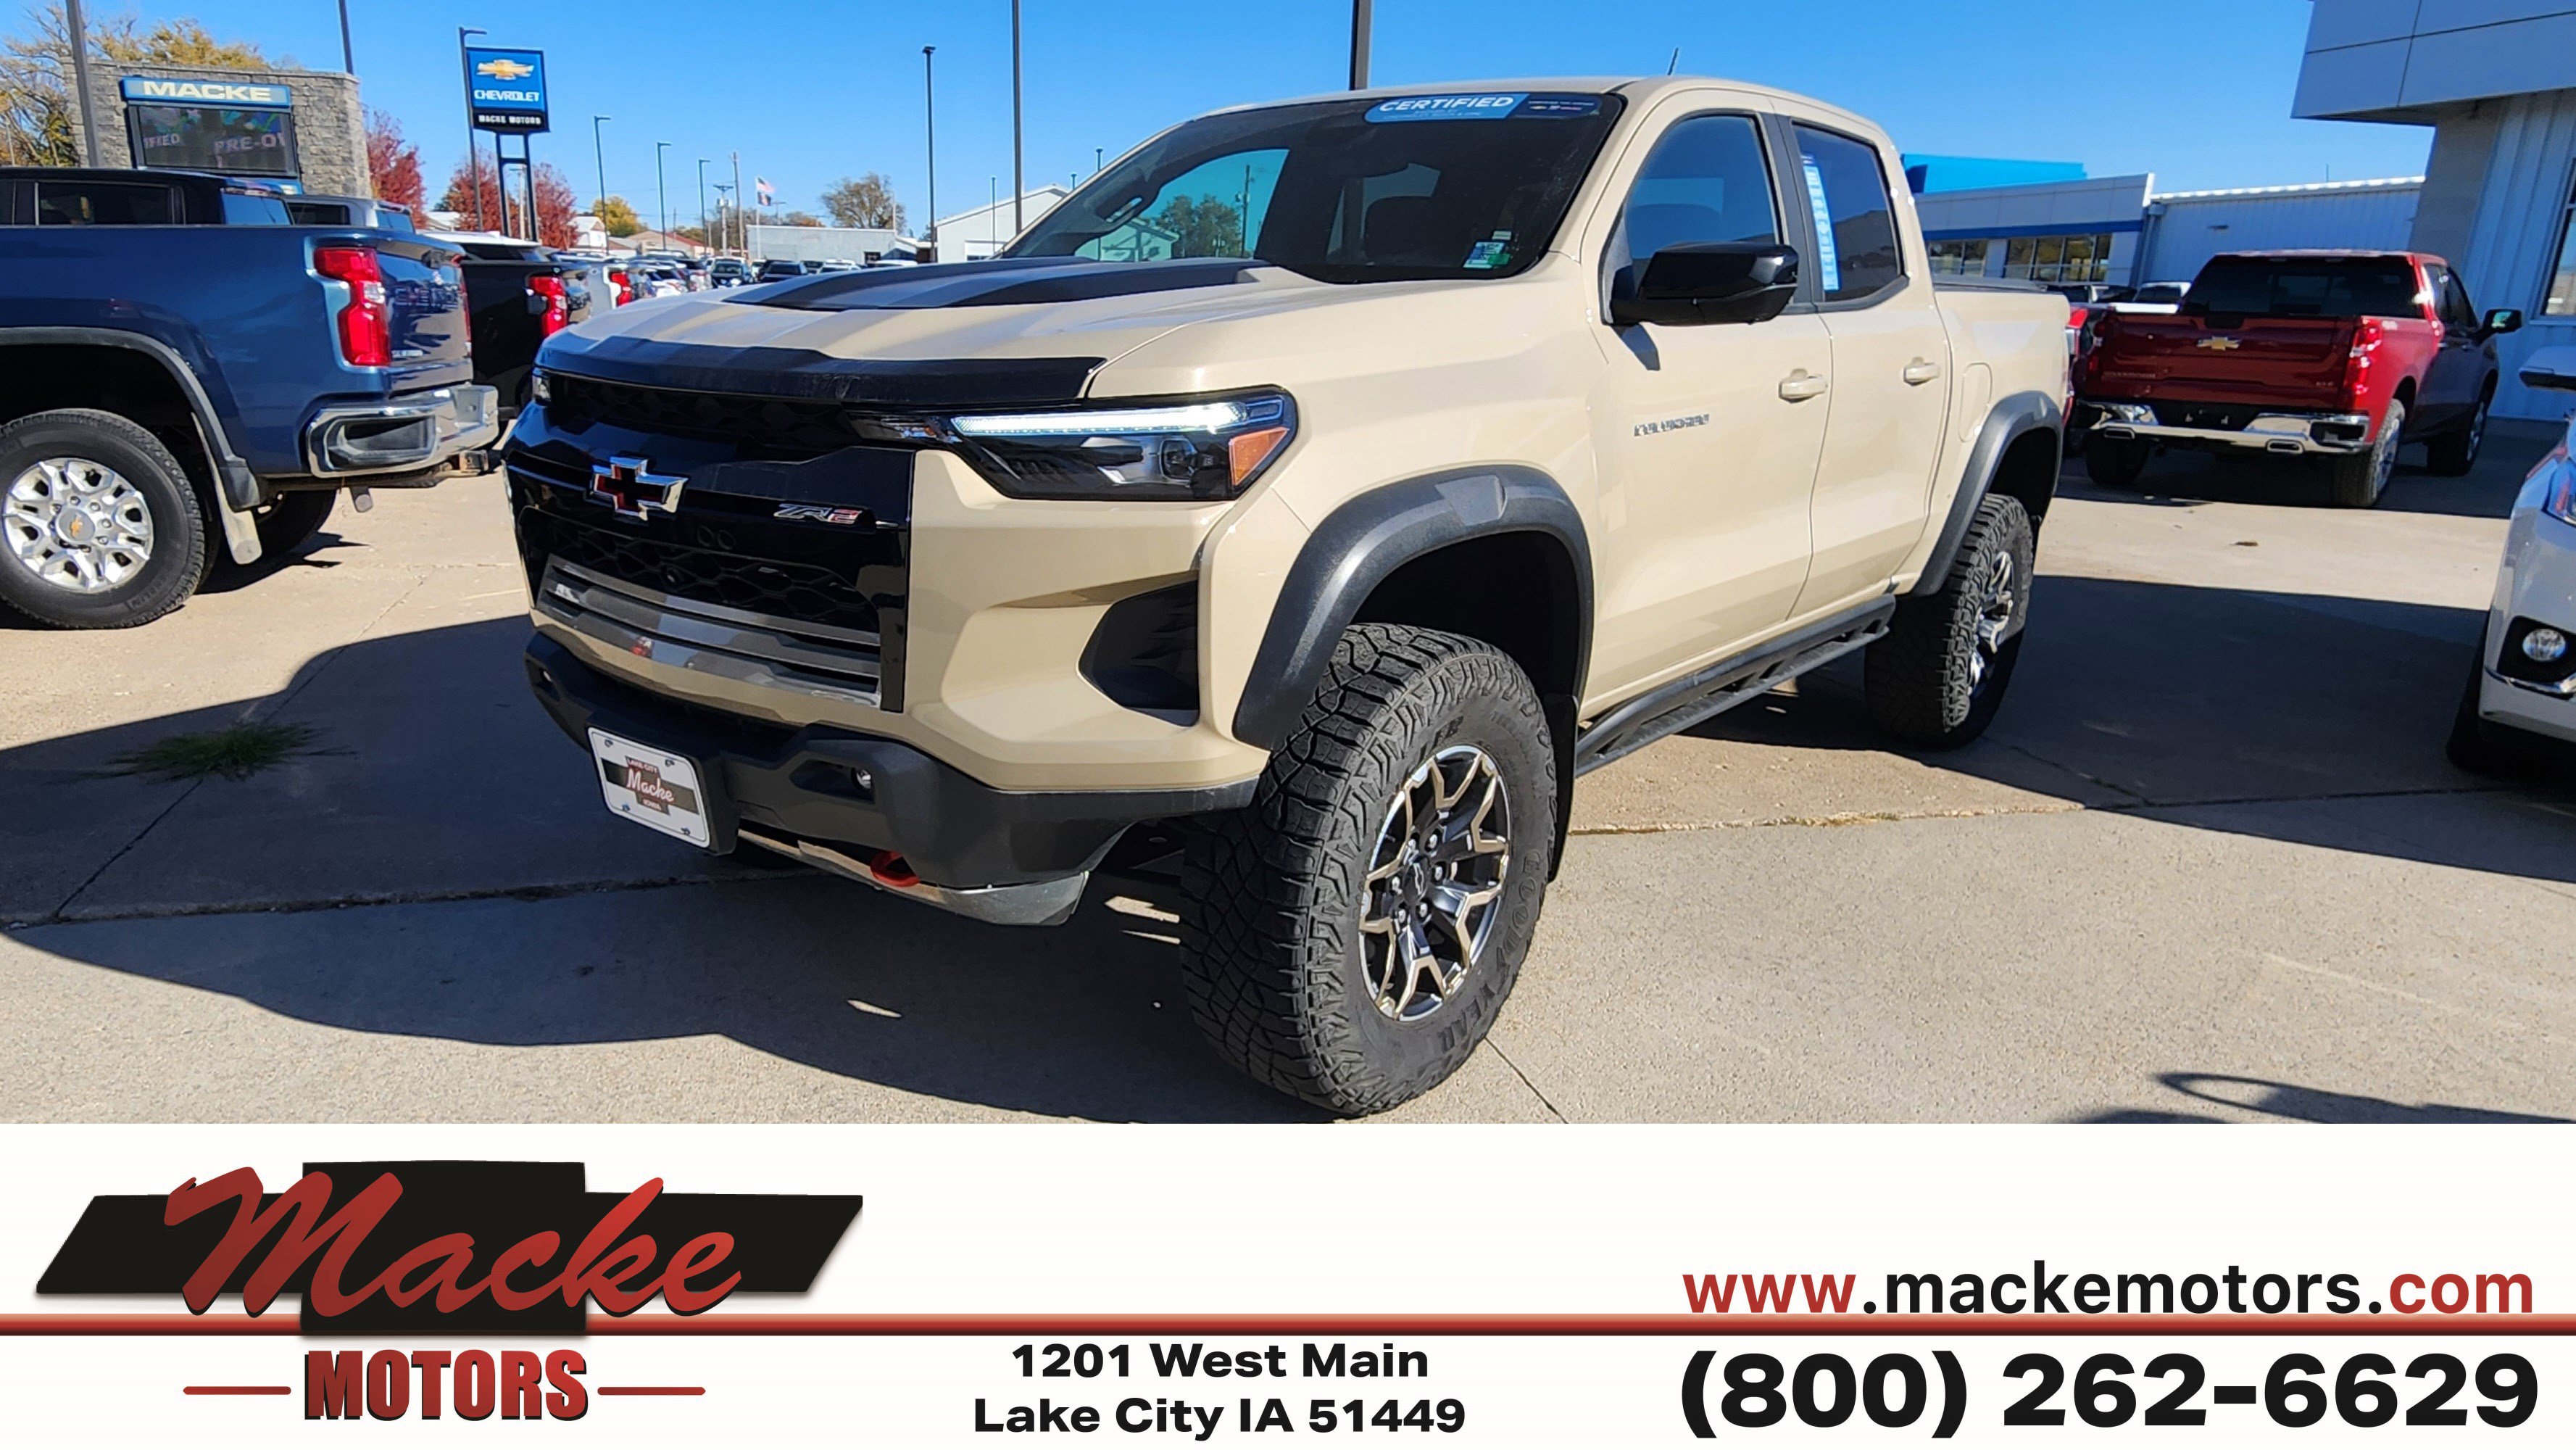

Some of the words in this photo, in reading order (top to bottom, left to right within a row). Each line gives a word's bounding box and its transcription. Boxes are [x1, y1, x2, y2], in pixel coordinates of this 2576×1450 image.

[143, 80, 273, 102] MACKE
[473, 88, 540, 102] CHEVROLET
[1379, 96, 1514, 112] CERTIFIED
[478, 115, 507, 123] MACKE
[508, 115, 541, 125] MOTORS
[773, 503, 863, 525] ZR2
[627, 768, 675, 802] Macke
